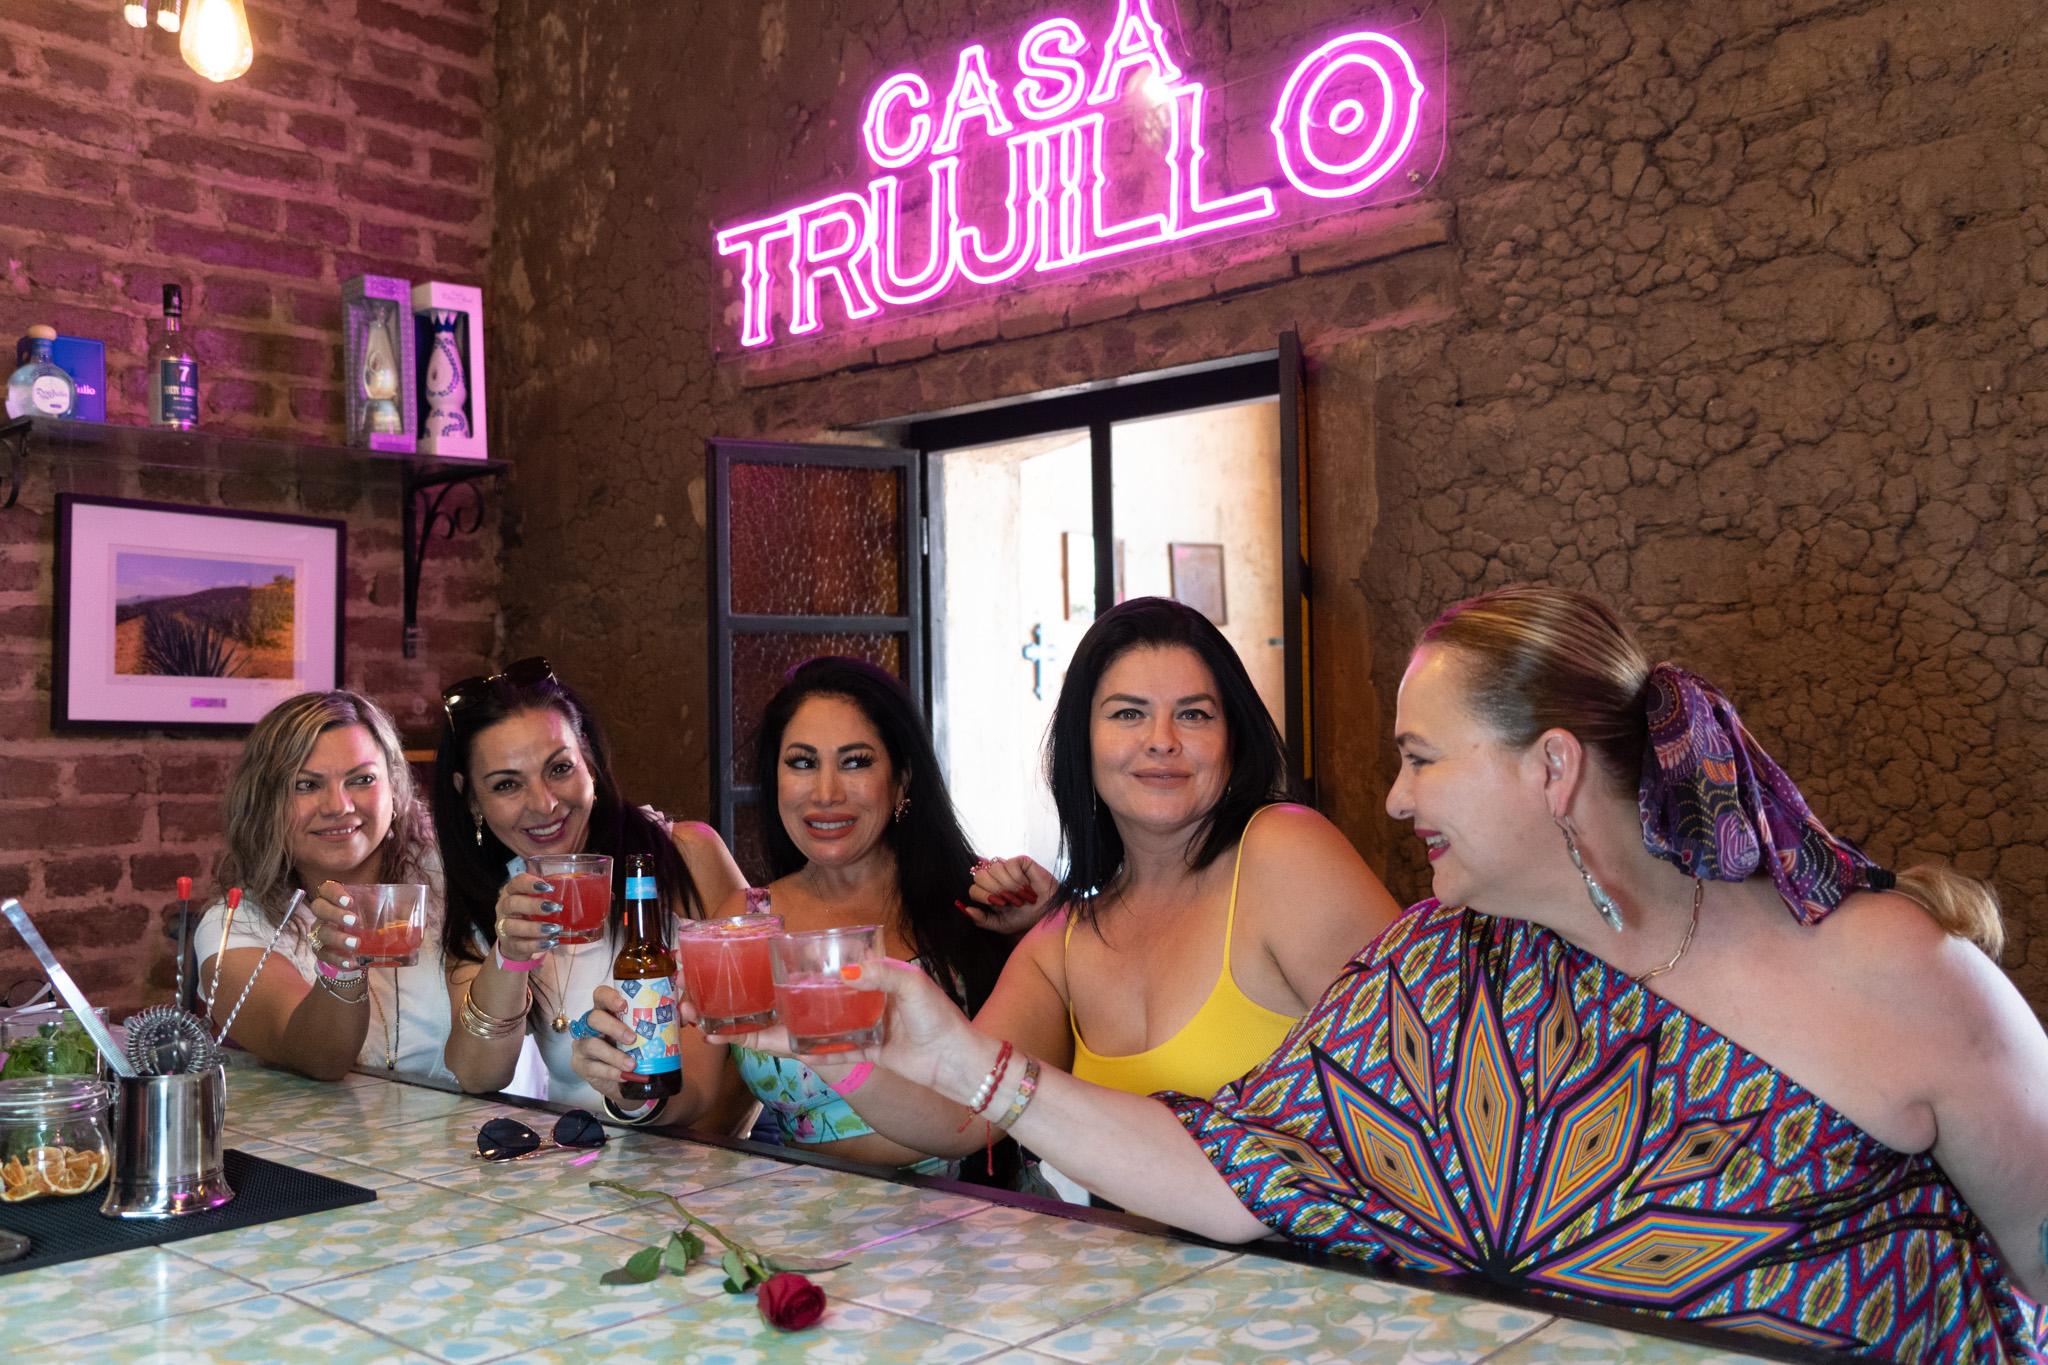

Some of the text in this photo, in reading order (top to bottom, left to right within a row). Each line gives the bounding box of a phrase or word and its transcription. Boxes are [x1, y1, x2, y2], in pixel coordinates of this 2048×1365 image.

[863, 0, 1183, 168] CASA
[716, 31, 1426, 346] TRUJILLO
[179, 366, 190, 382] 7
